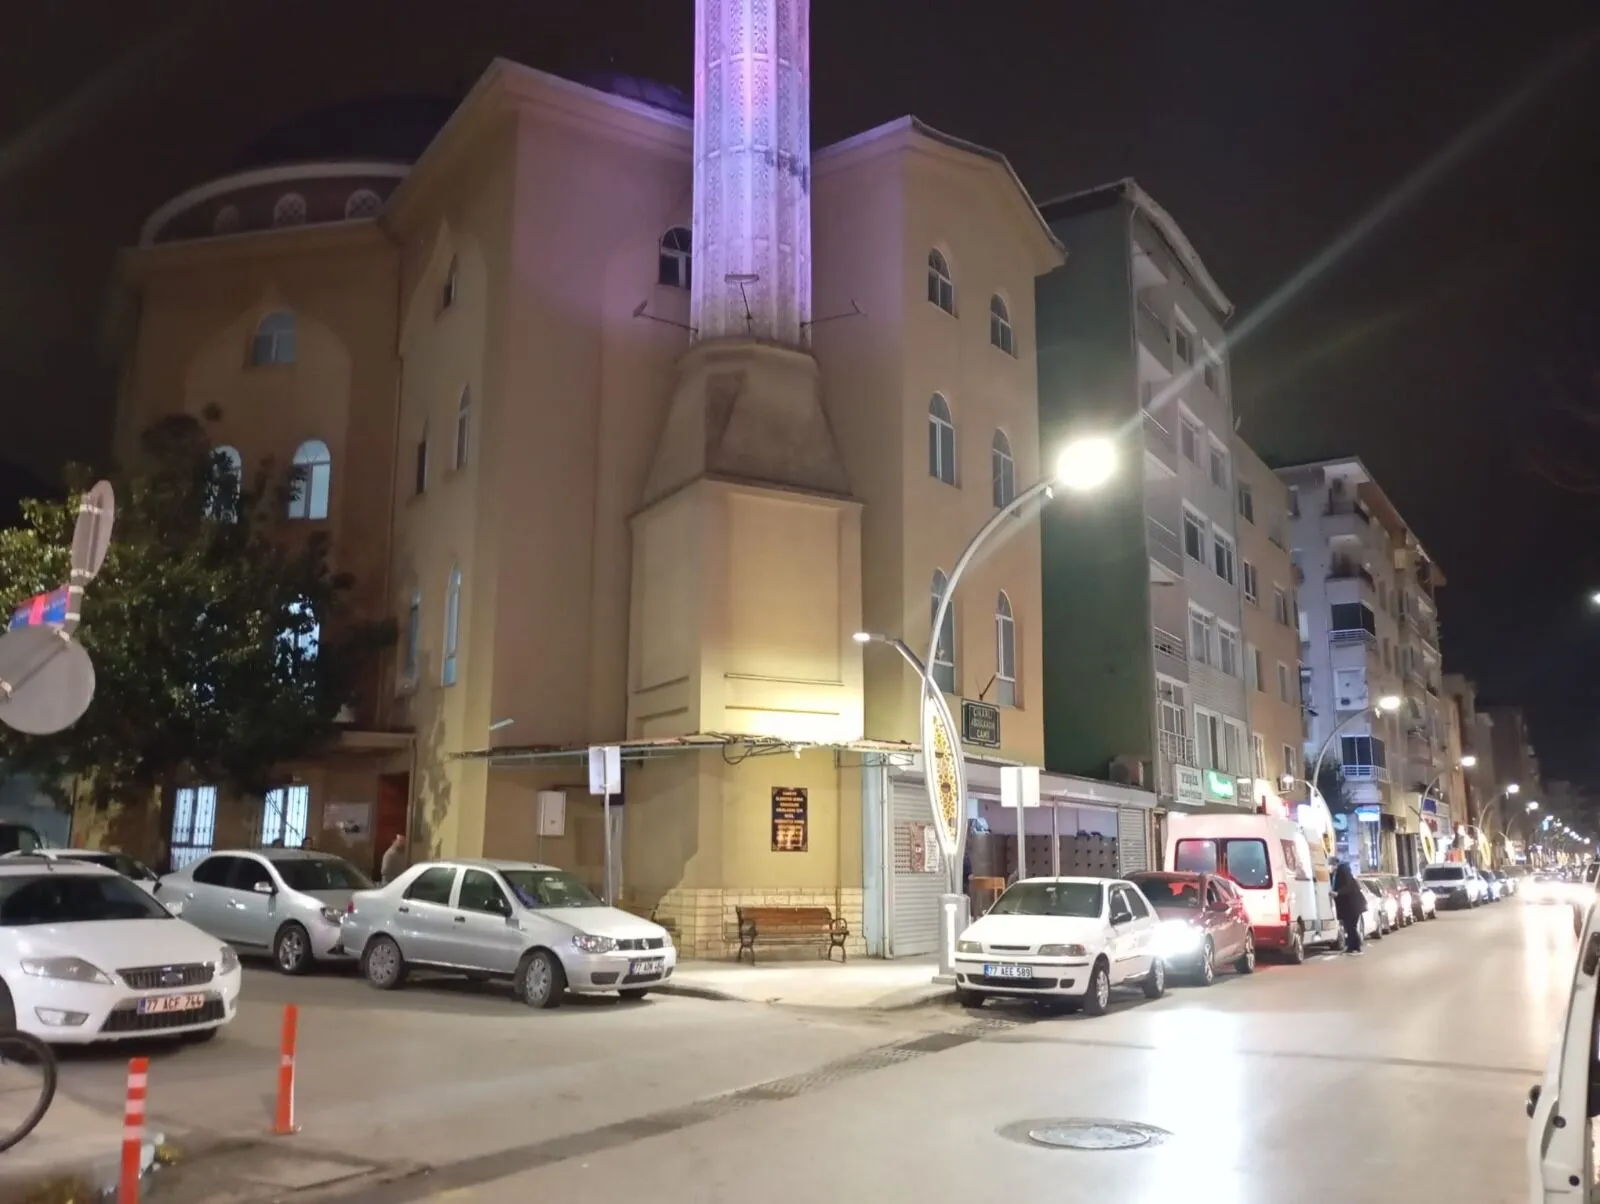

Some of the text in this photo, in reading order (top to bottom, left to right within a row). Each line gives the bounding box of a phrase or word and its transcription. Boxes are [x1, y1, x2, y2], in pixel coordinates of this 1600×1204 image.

[990, 966, 1031, 977] 77 AEE 589
[147, 998, 158, 1010] 77
[163, 996, 179, 1009] ACF
